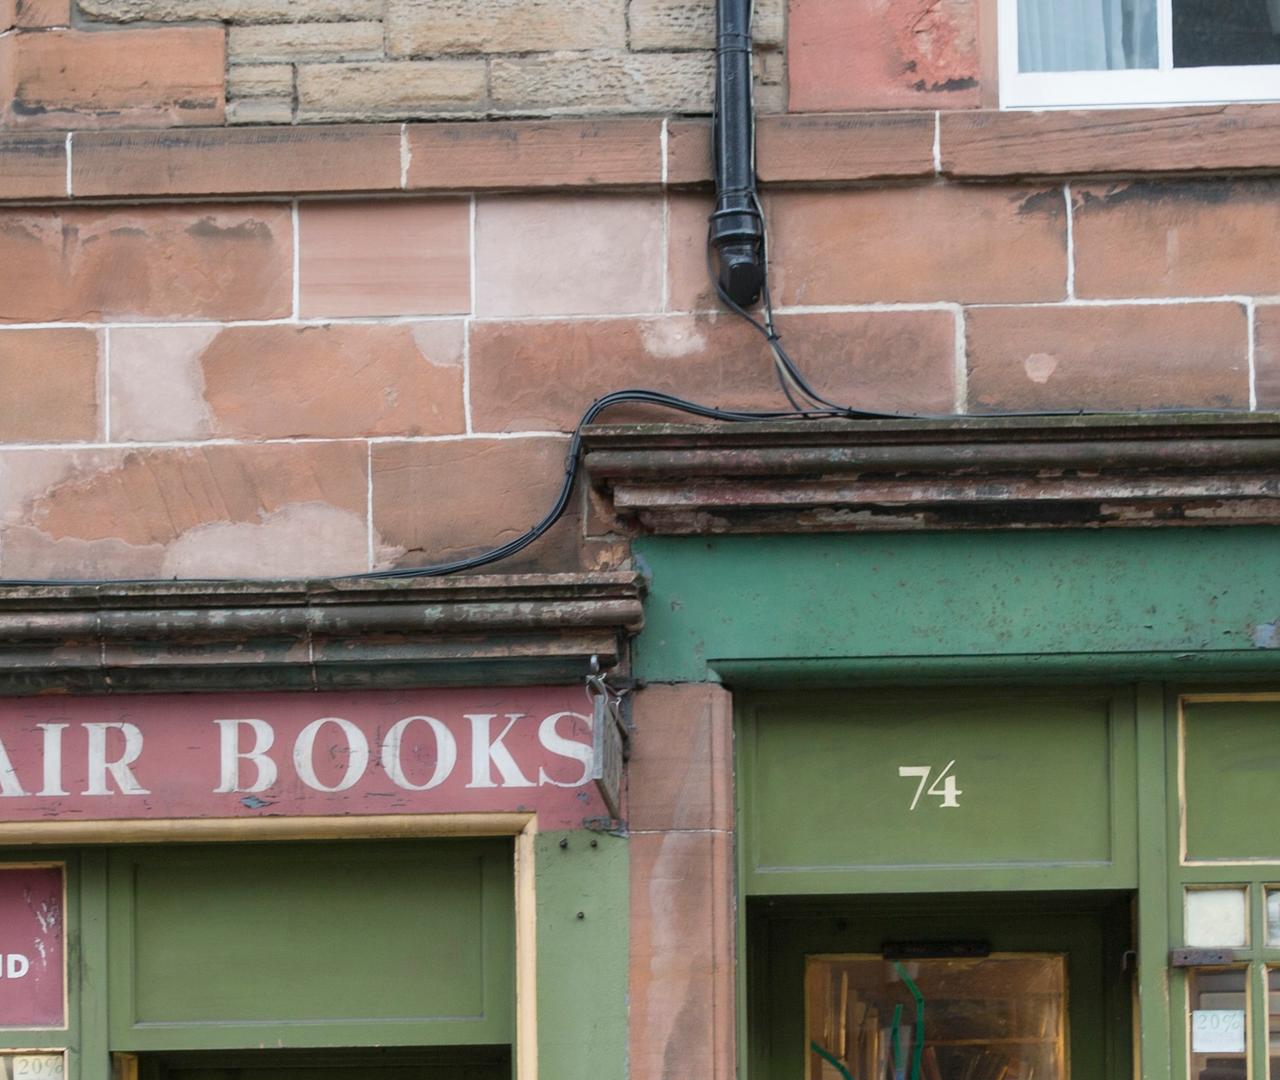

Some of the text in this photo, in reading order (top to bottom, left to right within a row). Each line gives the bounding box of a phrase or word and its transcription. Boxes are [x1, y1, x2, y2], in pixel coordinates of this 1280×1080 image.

[212, 710, 595, 794] BOOKS
[898, 759, 963, 811] 74
[1197, 1014, 1241, 1032] 20%
[19, 1058, 64, 1076] 20%
